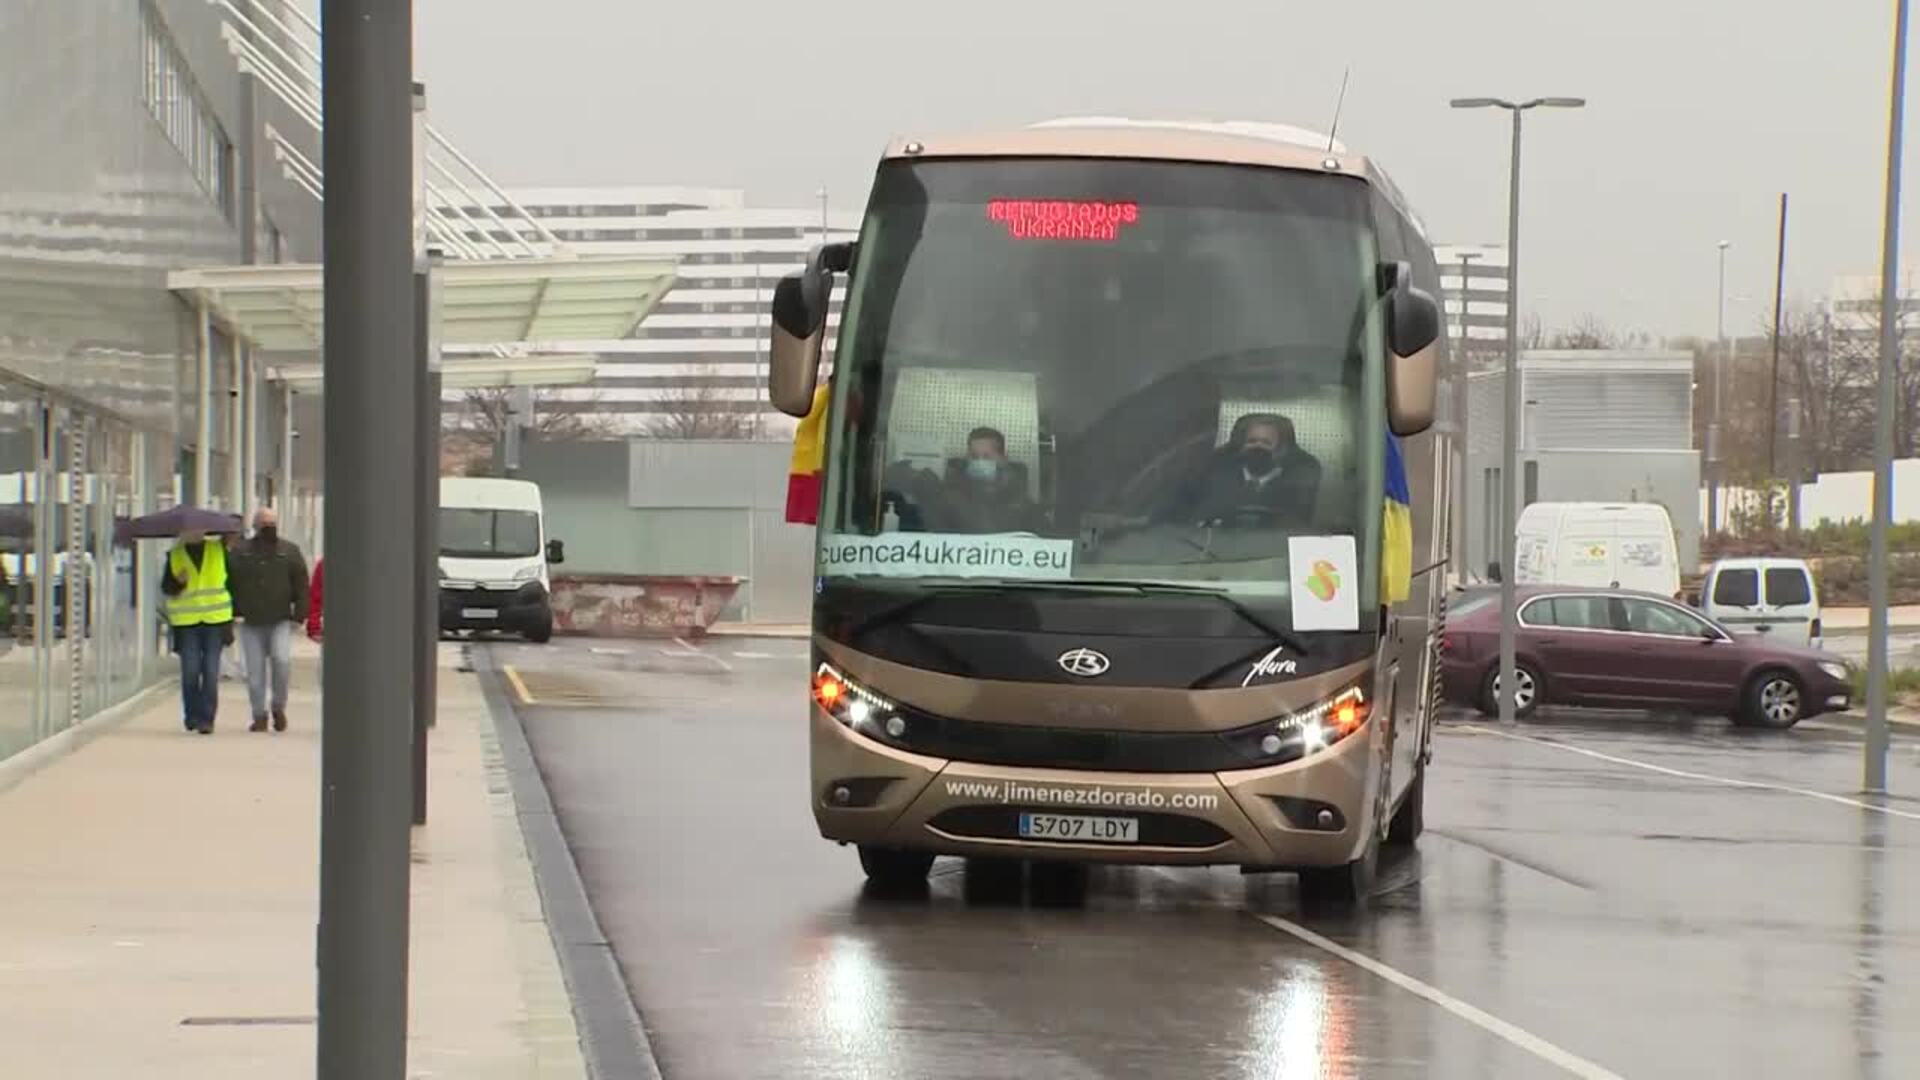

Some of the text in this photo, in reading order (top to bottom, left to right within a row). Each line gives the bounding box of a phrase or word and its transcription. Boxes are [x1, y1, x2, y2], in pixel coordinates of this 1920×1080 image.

[988, 200, 1138, 222] REFUGIADOS
[1012, 218, 1116, 241] UKRANIA
[819, 539, 1068, 570] cuenca4ukraine.eu
[1241, 646, 1297, 687] Aura
[945, 779, 1218, 809] www.jimenezdorado.com
[1033, 817, 1130, 838] 5707 LDY
